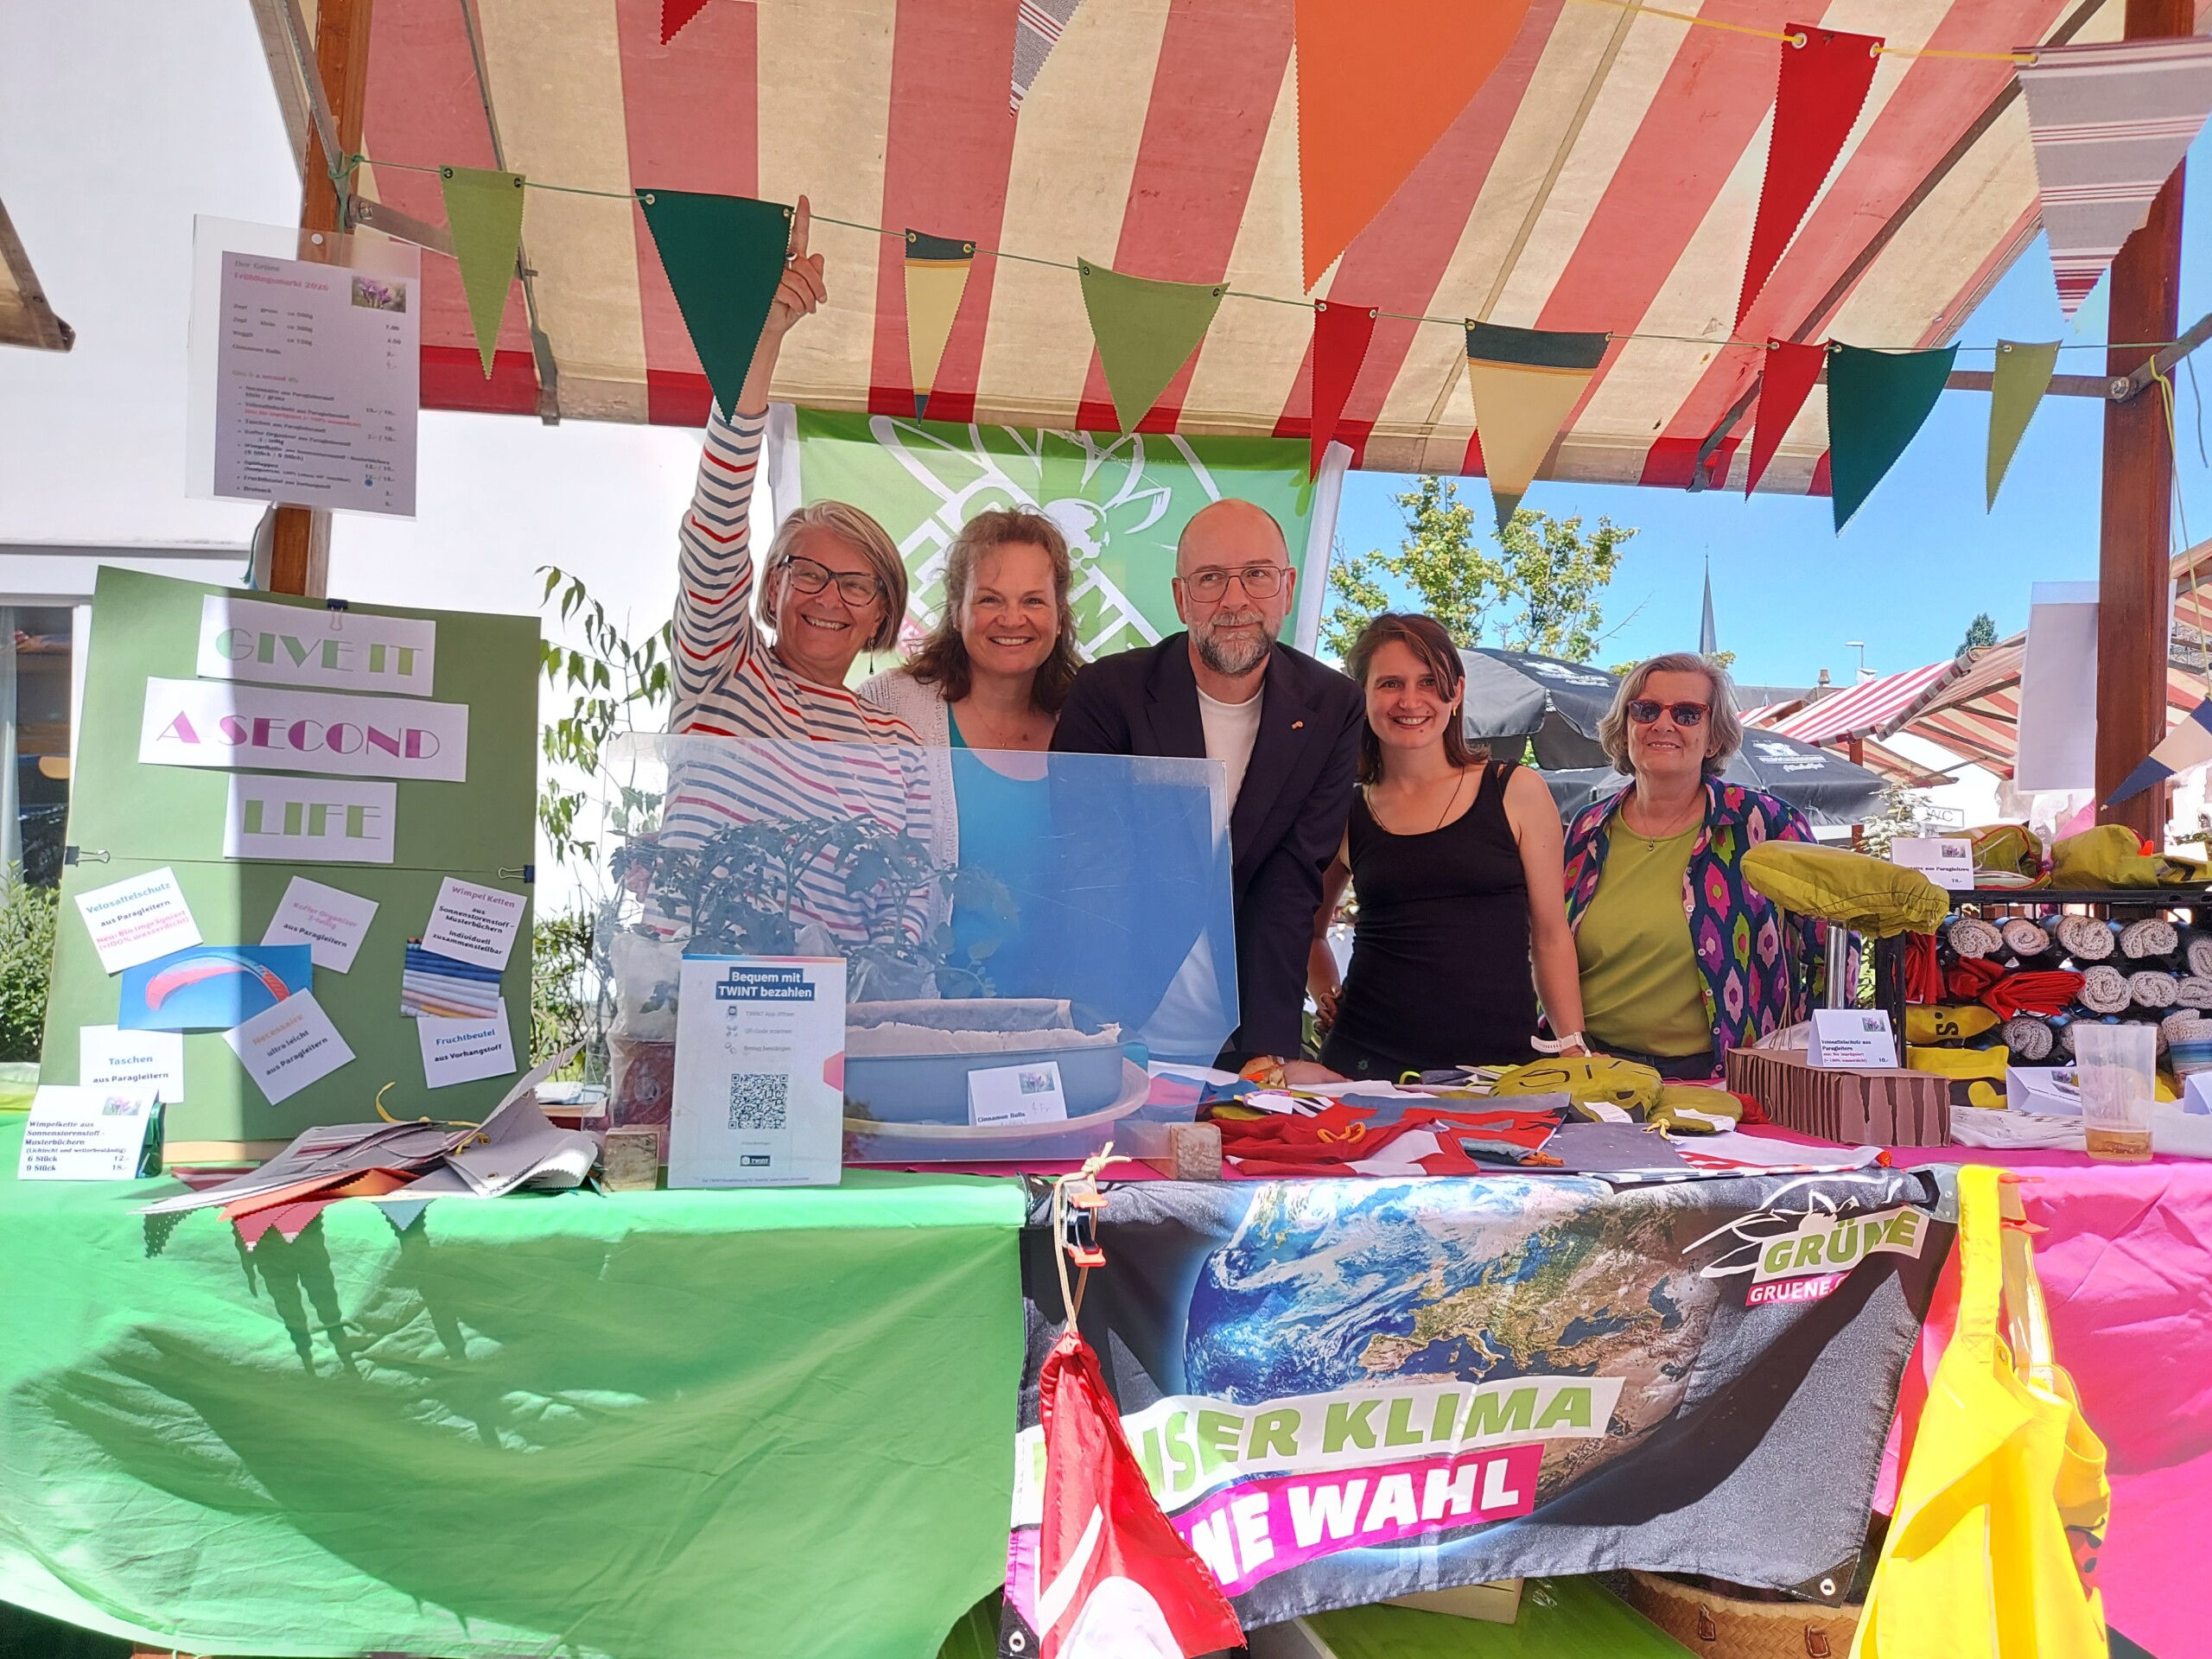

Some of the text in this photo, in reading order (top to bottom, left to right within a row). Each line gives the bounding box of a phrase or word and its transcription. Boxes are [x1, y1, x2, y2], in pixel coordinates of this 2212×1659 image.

[215, 628, 423, 677] GIVE IT
[156, 710, 441, 760] A SECOND
[243, 799, 382, 840] LIFE
[86, 881, 172, 914] Velosattelschutz
[451, 885, 516, 909] Wimpel Ketten
[100, 899, 171, 928] aus Paragleitern
[438, 905, 510, 929] Sonnenstorenstoff
[472, 906, 486, 916] aus
[283, 922, 349, 949] aus Paragleitern
[445, 914, 504, 934] Musterbüchern
[432, 932, 504, 956] zusammenstellbar
[448, 929, 493, 945] Individuell
[731, 971, 801, 986] Bequem mit
[718, 986, 812, 998] TWINT bezahlen
[266, 1029, 310, 1057] ultra leicht
[435, 1027, 497, 1047] Fruchtbeutel
[108, 1055, 154, 1066] Taschen
[265, 1037, 329, 1077] aus Paragleitern
[434, 1043, 503, 1063] aus Vorhangstoff
[111, 1071, 169, 1084] Paragleitern
[29, 1120, 79, 1129] Wimpelkette
[977, 1114, 1009, 1123] Cinnamon
[1009, 1111, 1027, 1120] Rolls
[34, 1164, 57, 1173] Stück
[35, 1154, 59, 1163] Stück
[1764, 1211, 1921, 1274] GRÜNE
[1322, 1387, 1592, 1454] KLIMA
[1286, 1458, 1520, 1549] WAHL
